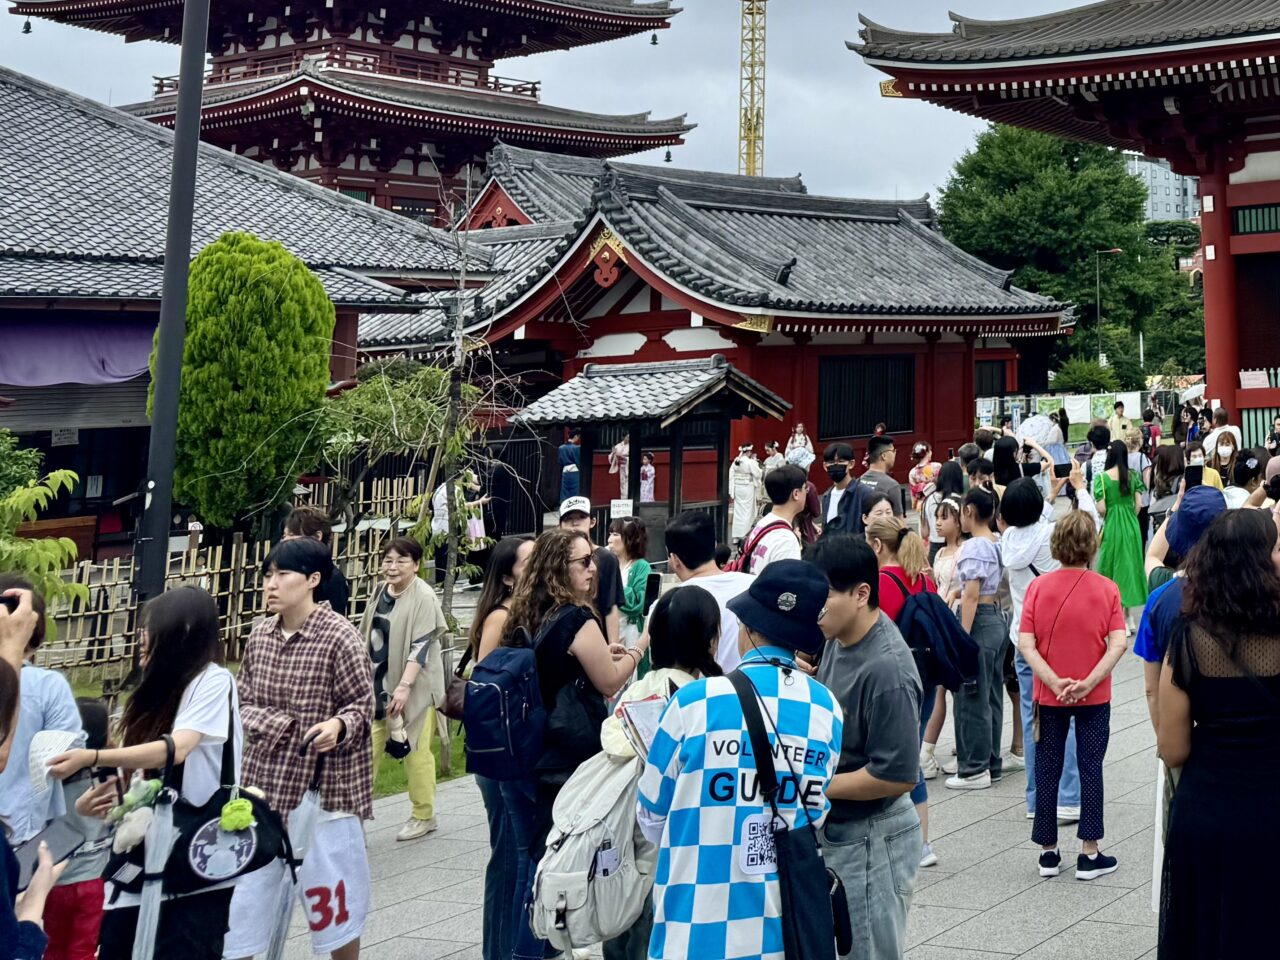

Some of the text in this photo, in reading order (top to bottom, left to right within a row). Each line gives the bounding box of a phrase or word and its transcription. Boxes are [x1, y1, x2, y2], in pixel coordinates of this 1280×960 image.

[712, 739, 826, 768] VOLNTEER
[707, 772, 823, 807] GUDE
[305, 879, 349, 932] 31
